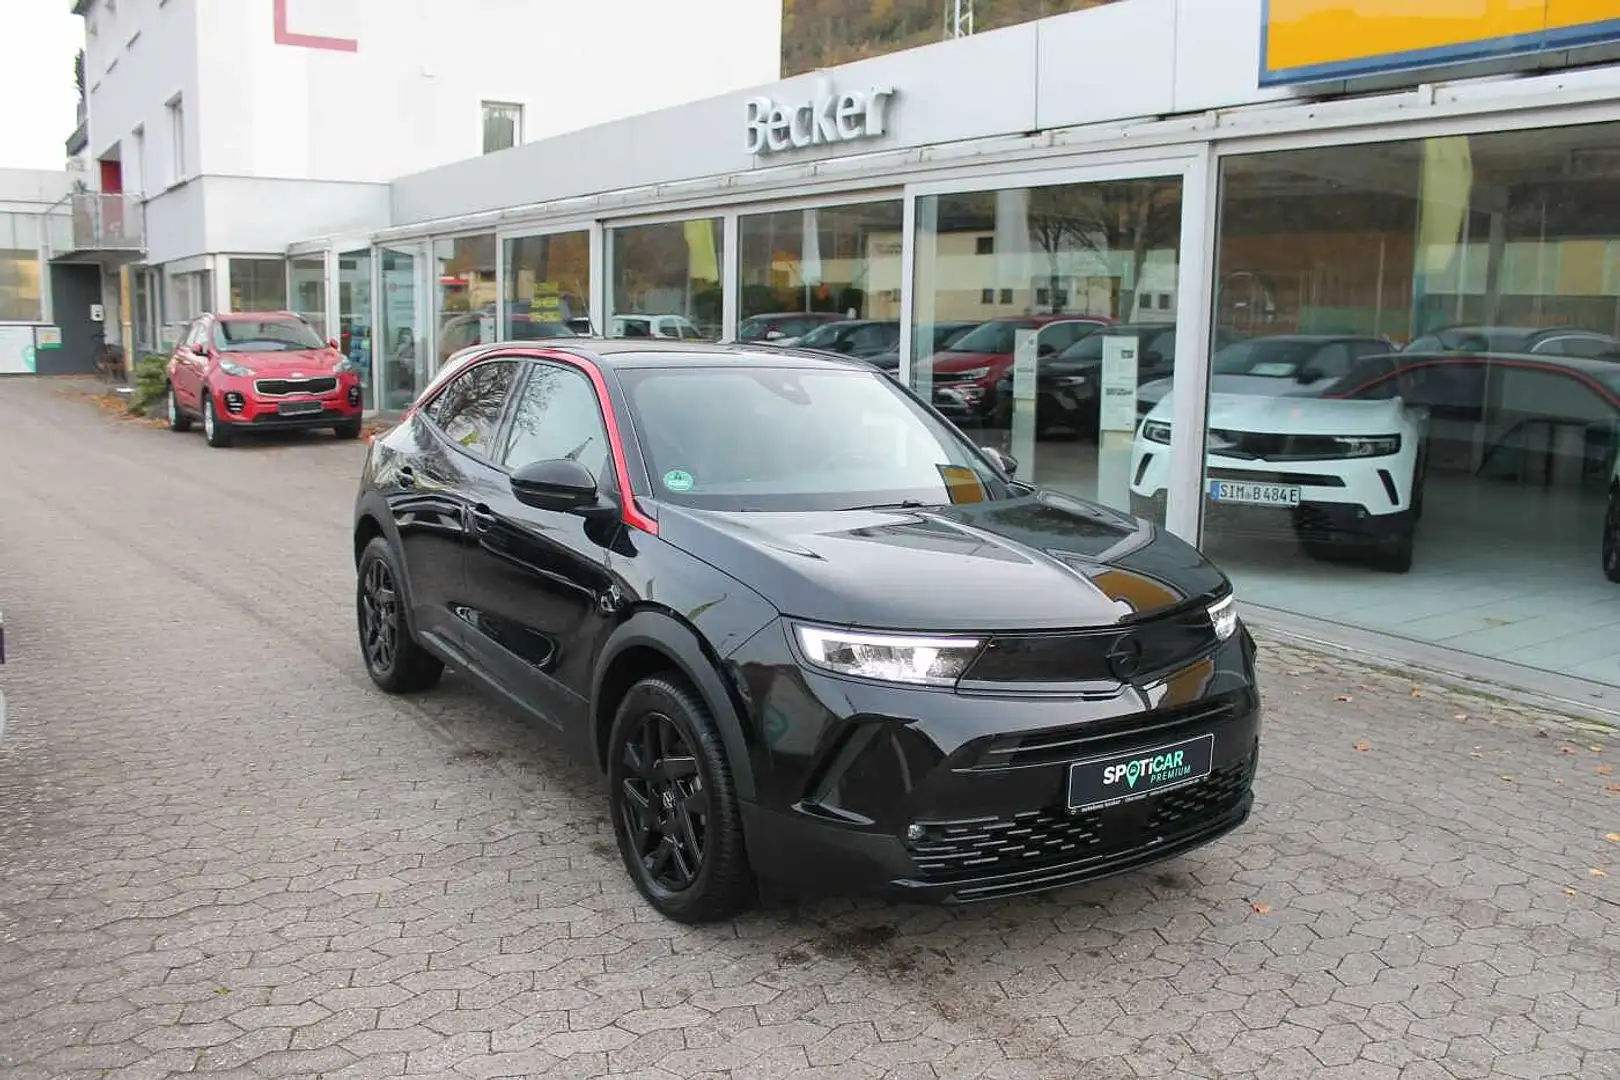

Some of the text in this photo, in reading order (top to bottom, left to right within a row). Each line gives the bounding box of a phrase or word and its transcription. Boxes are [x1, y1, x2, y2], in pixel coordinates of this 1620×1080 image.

[745, 71, 896, 154] Becker
[1220, 484, 1244, 500] SIM
[1150, 764, 1191, 784] PREMIUM
